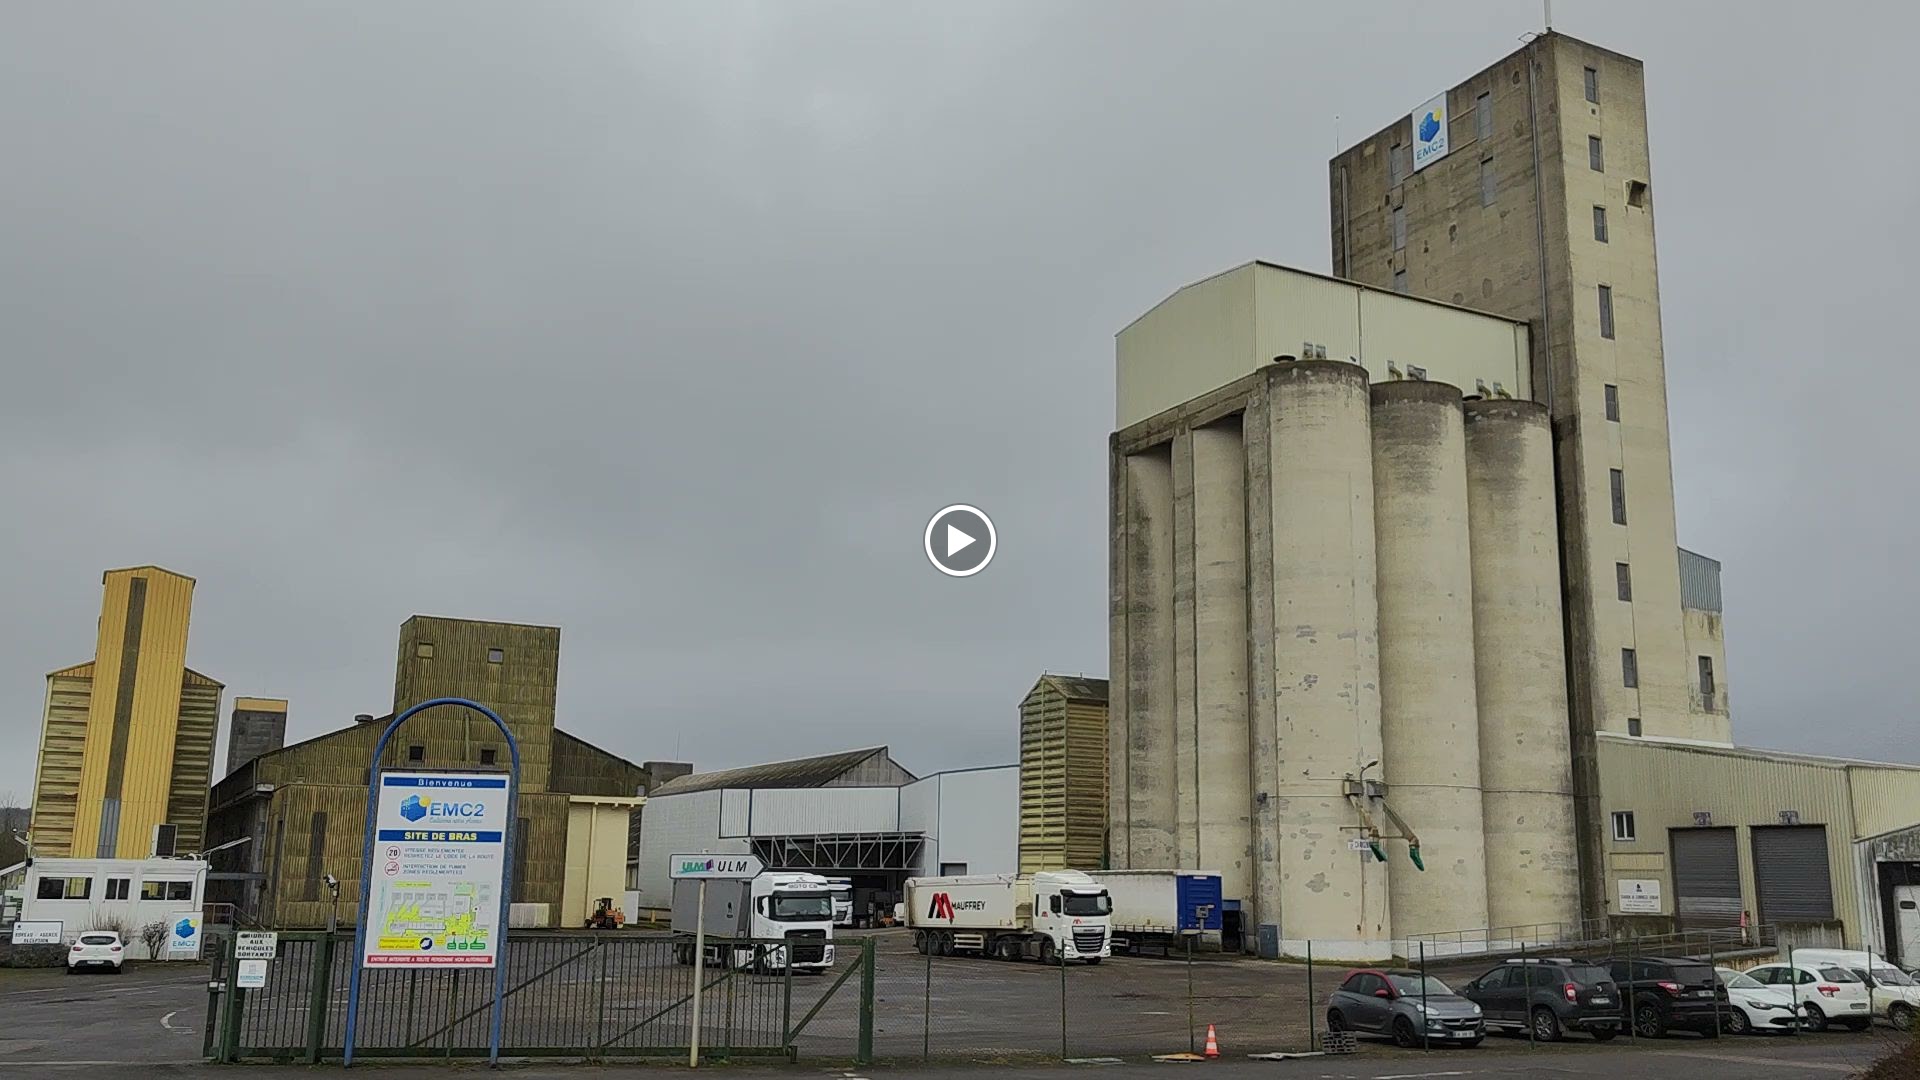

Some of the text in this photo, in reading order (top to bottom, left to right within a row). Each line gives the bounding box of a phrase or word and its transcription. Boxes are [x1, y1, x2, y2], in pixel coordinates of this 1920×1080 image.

[1416, 138, 1445, 160] EMC2
[418, 778, 473, 787] Bienvenue
[430, 802, 484, 816] EMC2
[404, 832, 478, 841] SITE DE BRAS
[718, 861, 748, 872] ULM
[951, 901, 986, 910] MAUFFREY
